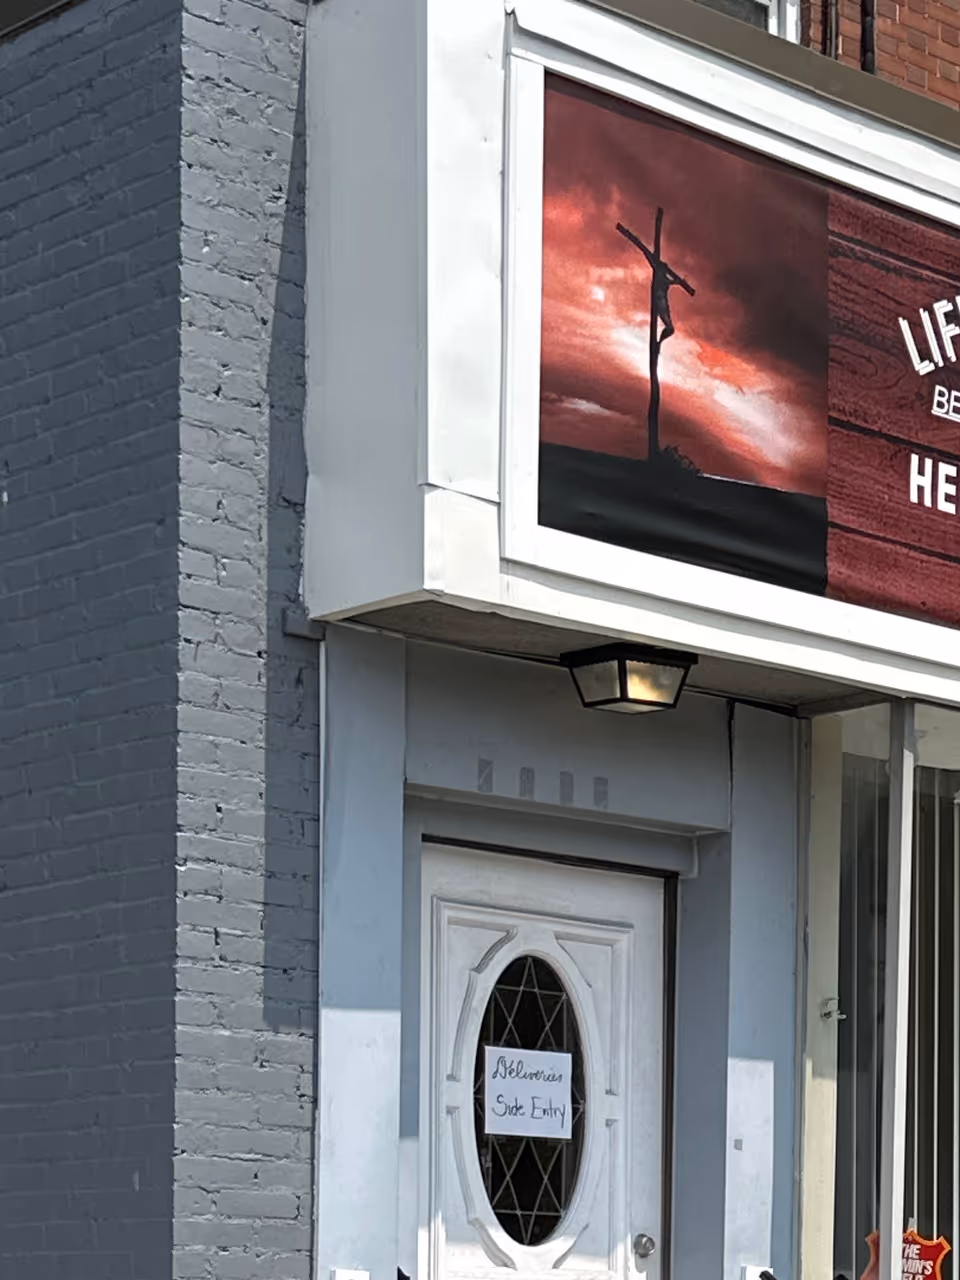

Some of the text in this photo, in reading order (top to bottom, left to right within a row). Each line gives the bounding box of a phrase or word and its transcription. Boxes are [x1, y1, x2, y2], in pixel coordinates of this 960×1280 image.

[491, 1055, 564, 1083] Deliveries
[491, 1093, 567, 1130] Side Entry
